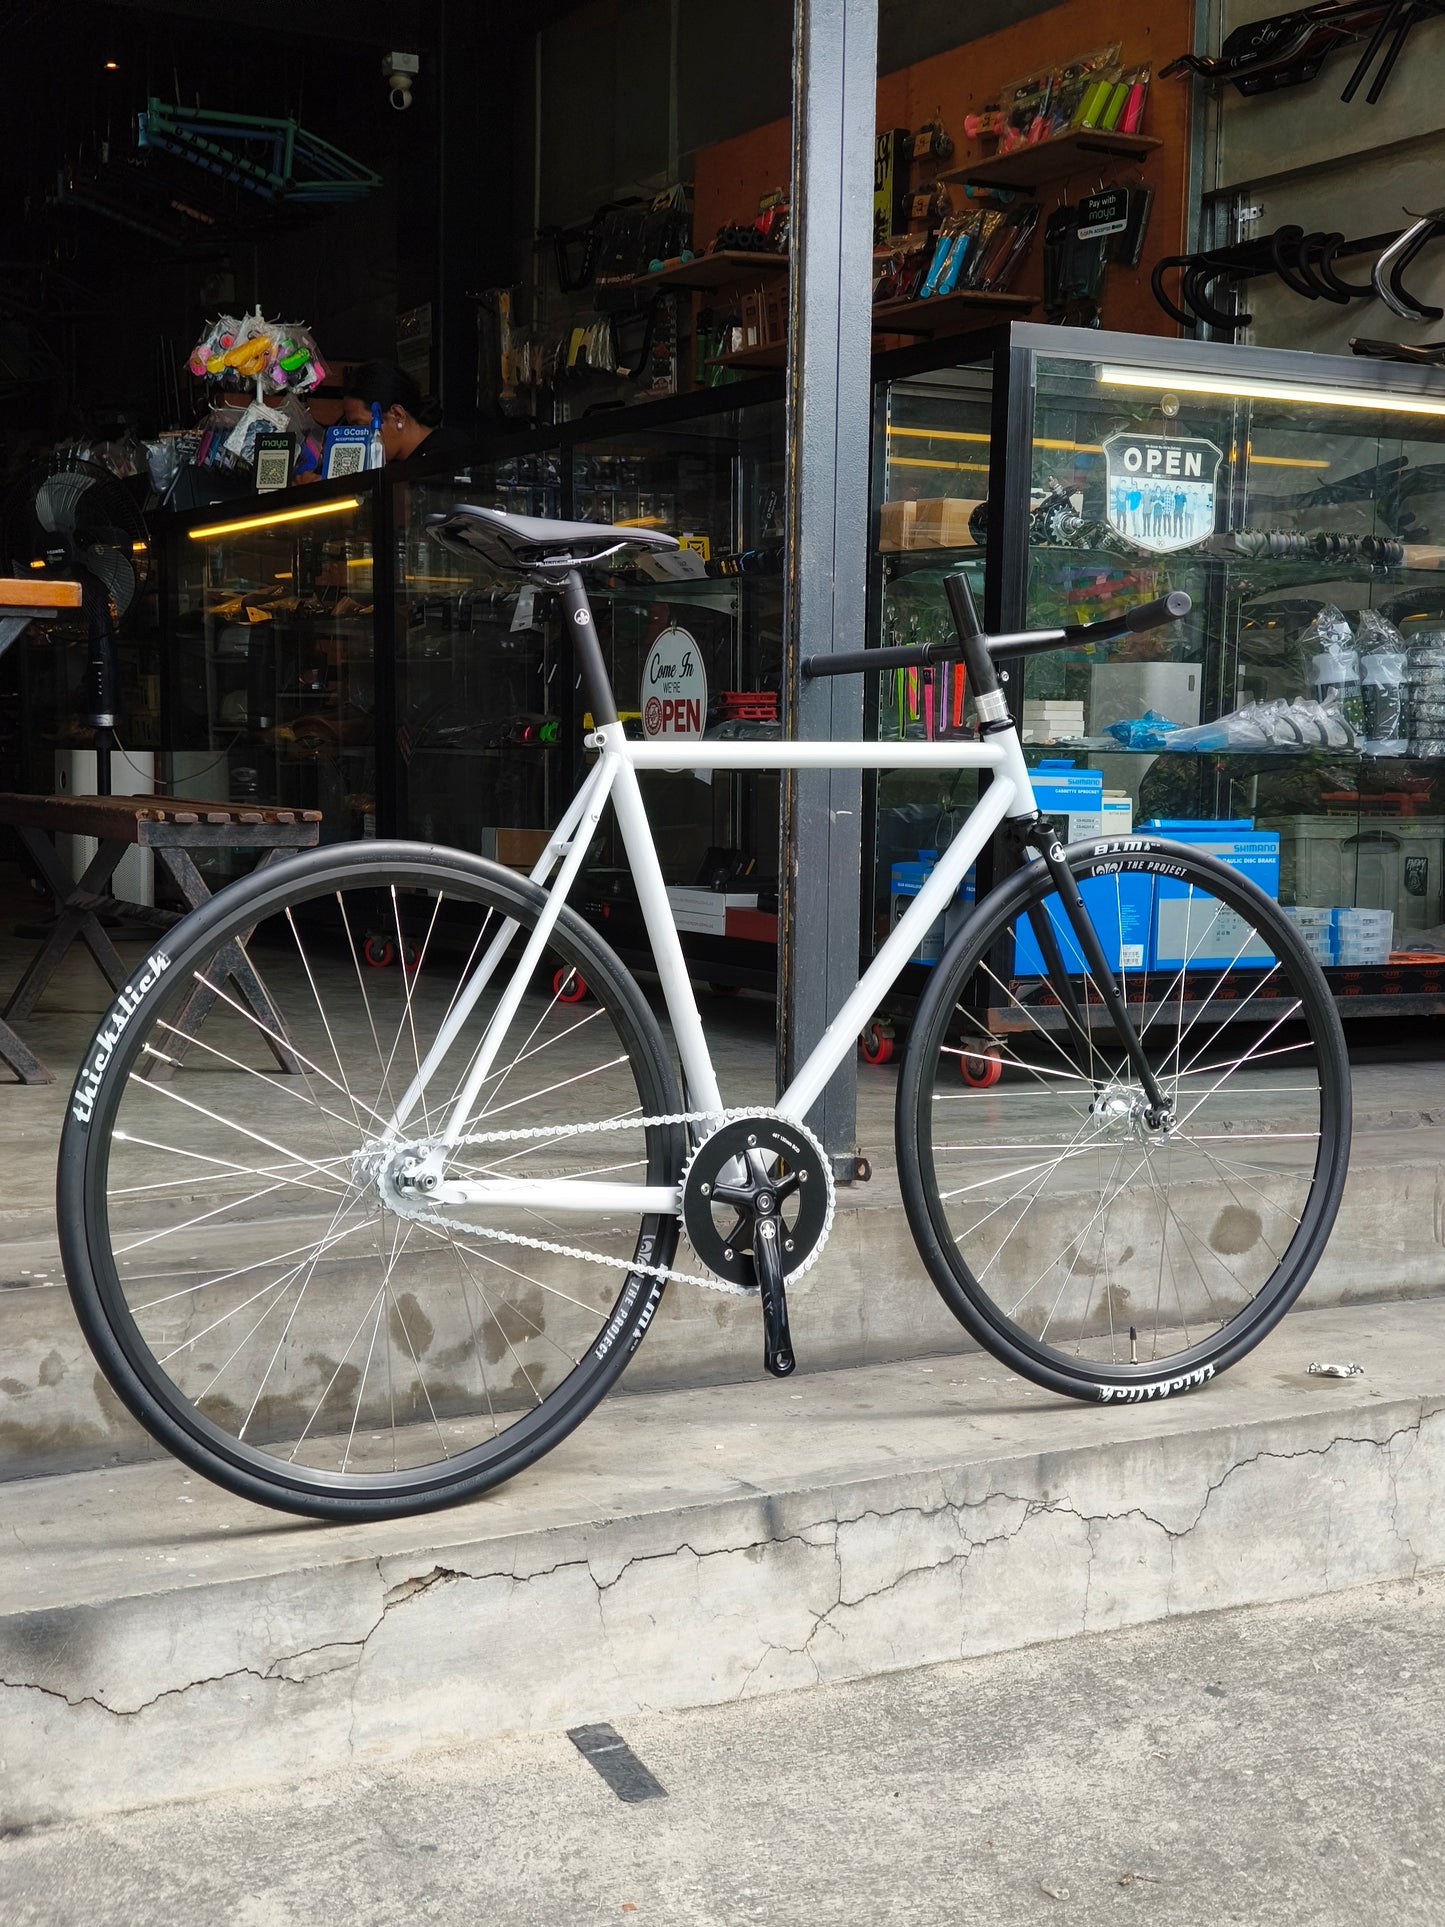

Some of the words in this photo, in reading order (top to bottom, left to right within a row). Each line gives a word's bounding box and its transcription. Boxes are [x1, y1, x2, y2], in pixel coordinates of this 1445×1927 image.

[1088, 199, 1101, 209] Pay
[1101, 194, 1117, 205] with
[1088, 206, 1116, 222] maya
[343, 428, 370, 437] GCash
[261, 438, 289, 449] maya
[1123, 447, 1202, 477] OPEN
[650, 652, 677, 684] Come
[678, 651, 695, 678] In
[662, 681, 681, 694] WE'RE
[1067, 778, 1100, 786] SHIMANO
[1233, 844, 1277, 853] SHIMANO
[1127, 860, 1145, 871] THE
[1147, 861, 1188, 877] PROJECT
[72, 952, 172, 1123] thickslick
[624, 1281, 640, 1307] THE
[594, 1308, 629, 1361] PROJECT
[1096, 1364, 1216, 1403] thickslick
